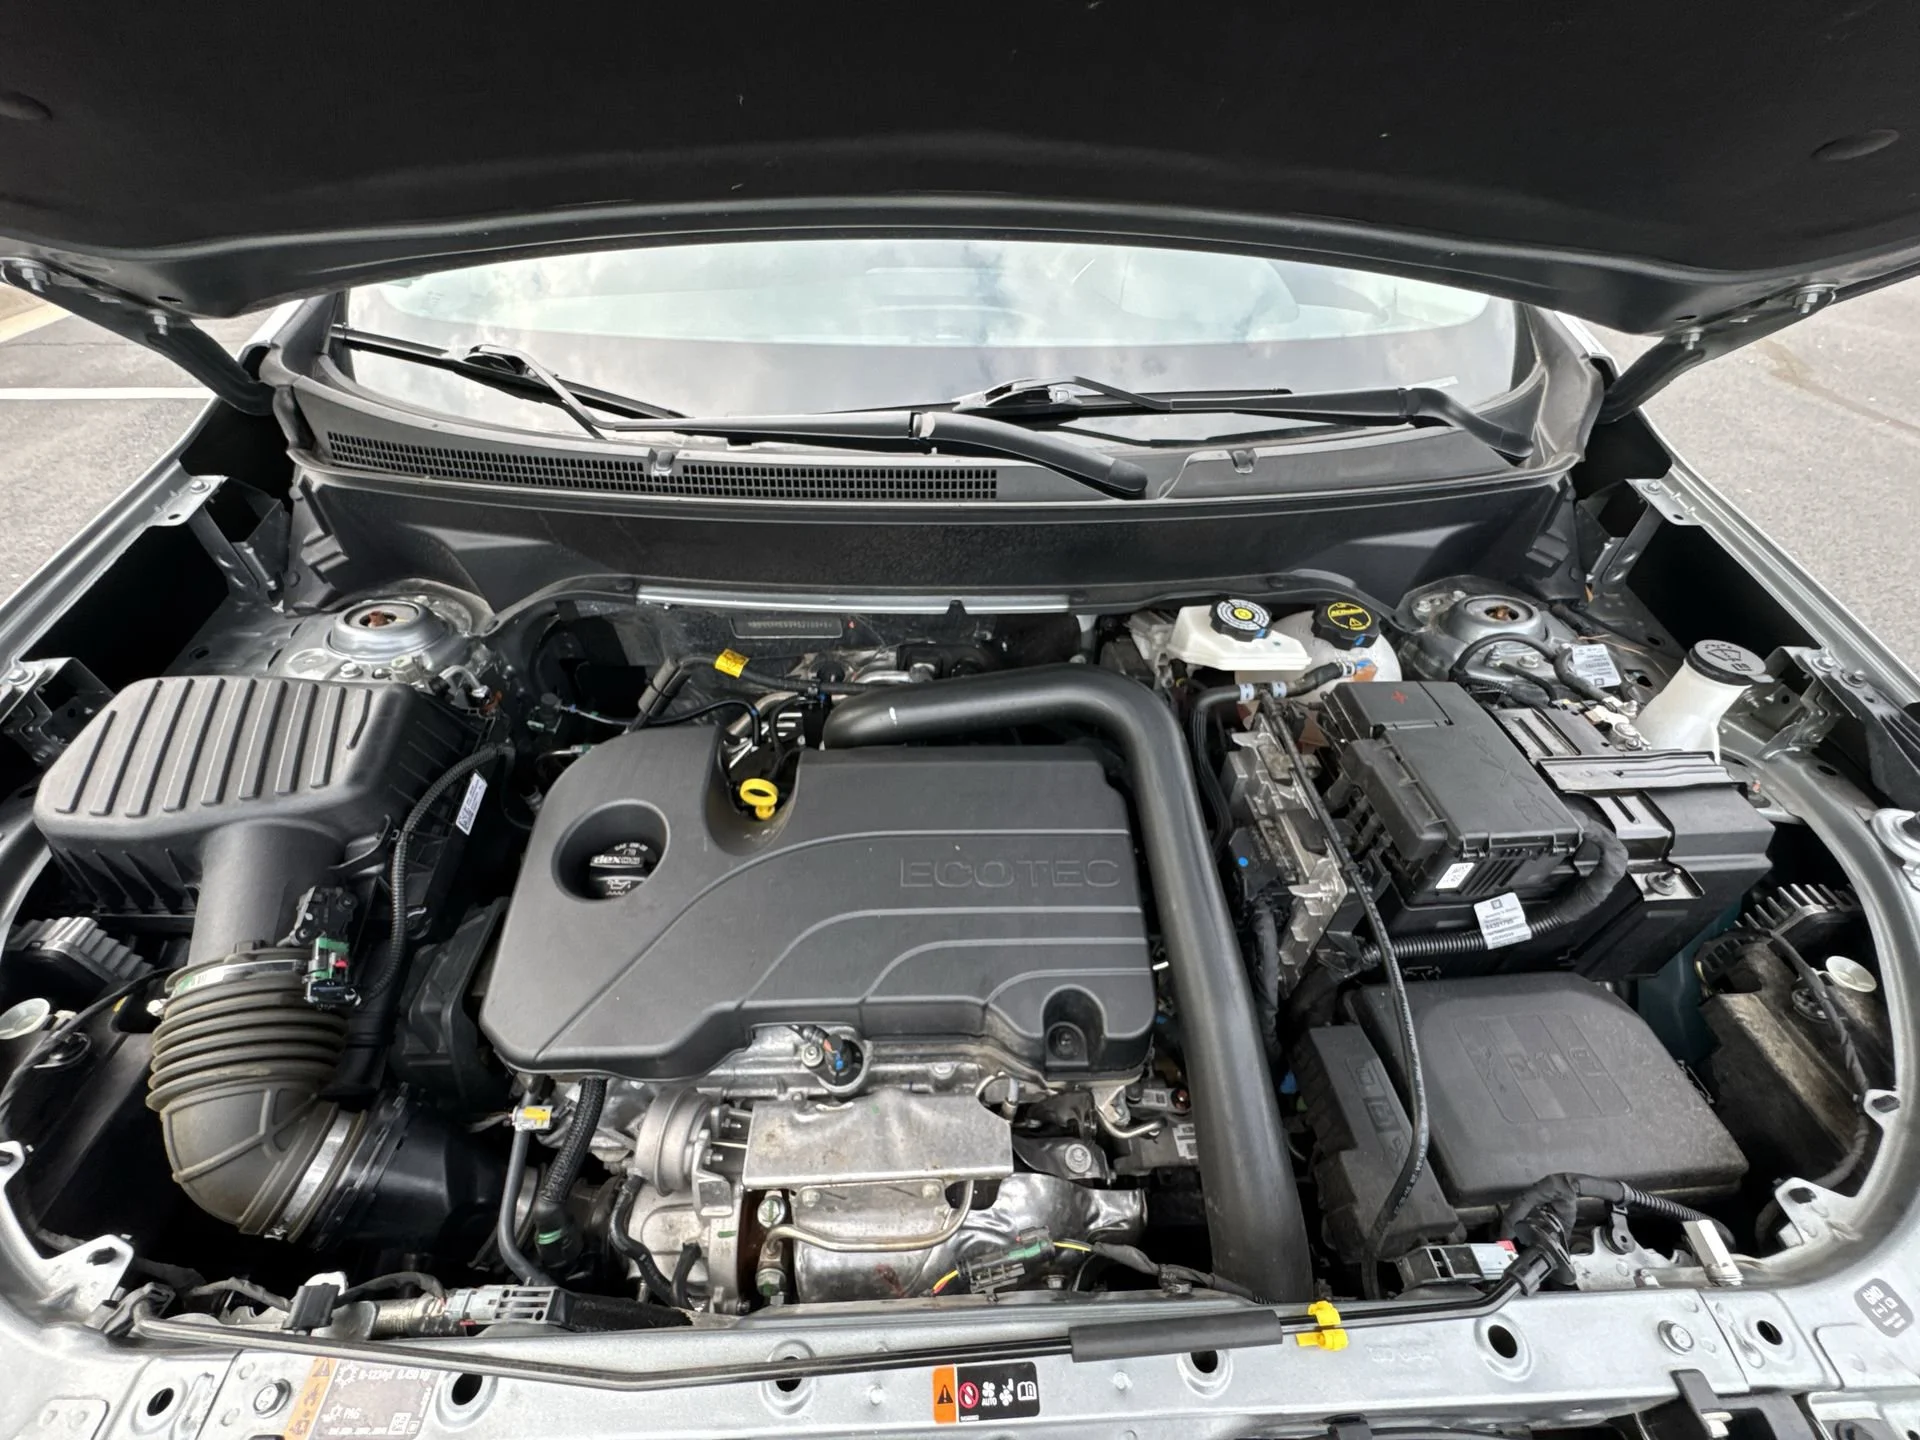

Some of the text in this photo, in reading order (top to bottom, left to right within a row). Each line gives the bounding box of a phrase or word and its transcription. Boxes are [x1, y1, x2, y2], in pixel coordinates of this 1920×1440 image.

[900, 857, 1120, 888] ECOTEC
[981, 1397, 998, 1406] AUTO
[343, 1408, 362, 1419] PAG
